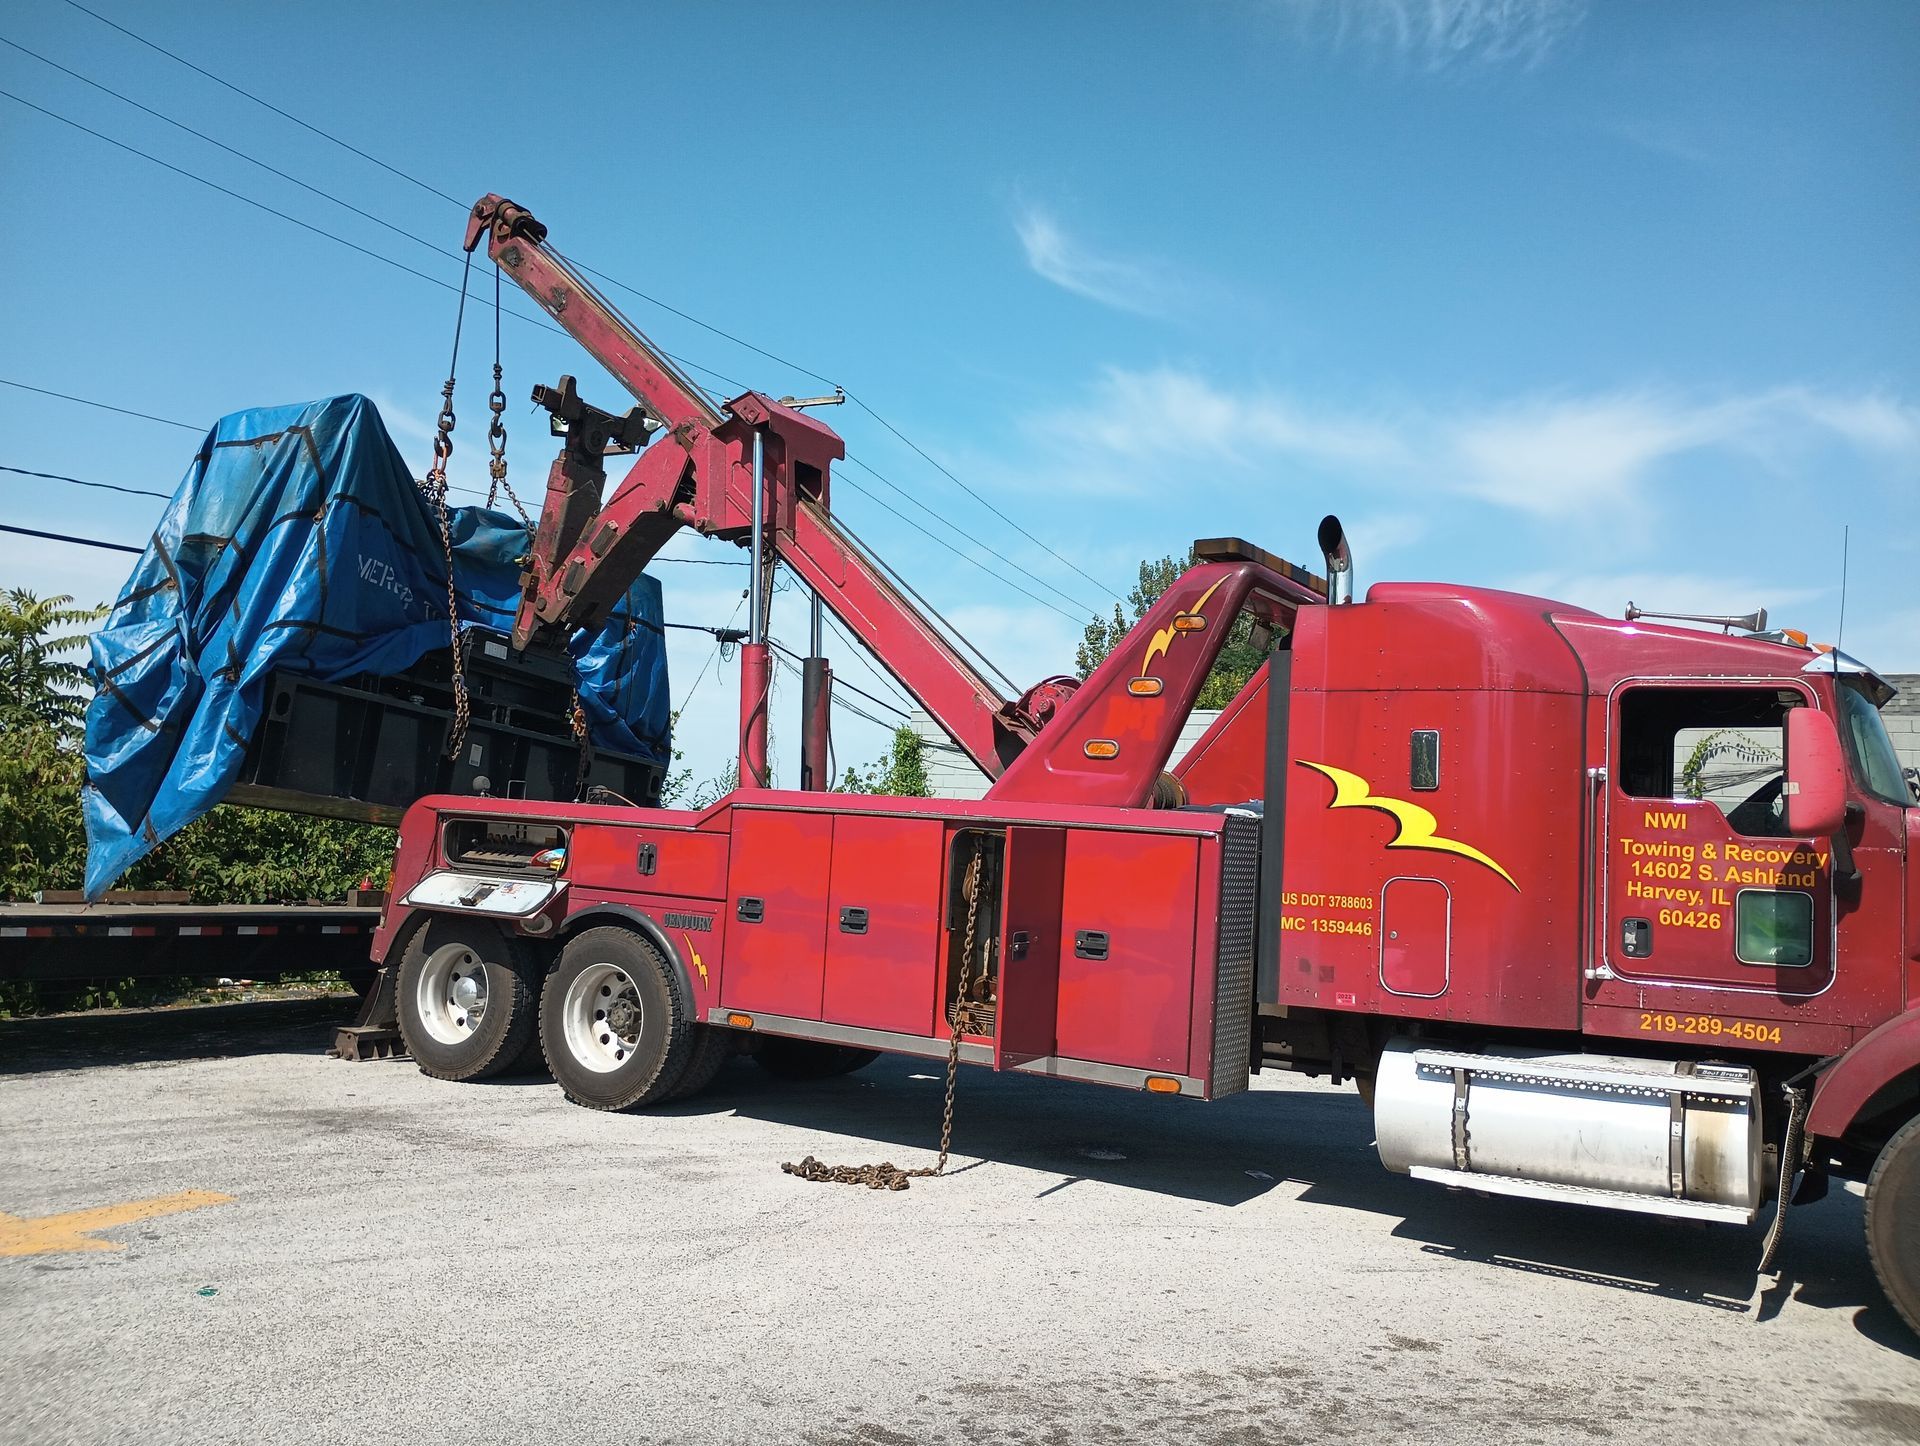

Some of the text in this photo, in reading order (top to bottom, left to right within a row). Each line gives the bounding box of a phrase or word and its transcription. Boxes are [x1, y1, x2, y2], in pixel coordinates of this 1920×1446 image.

[1645, 812, 1687, 831] NWI
[1620, 839, 1828, 870] Towing & Recovery
[1631, 861, 1816, 888] 14602 S. Ashland
[1282, 893, 1373, 910] US DOT 3788603
[1627, 882, 1731, 906] Harvey, IL
[1280, 916, 1373, 936] MC 1359446
[1659, 909, 1721, 929] 60426
[1640, 1013, 1782, 1044] 219-289-4504
